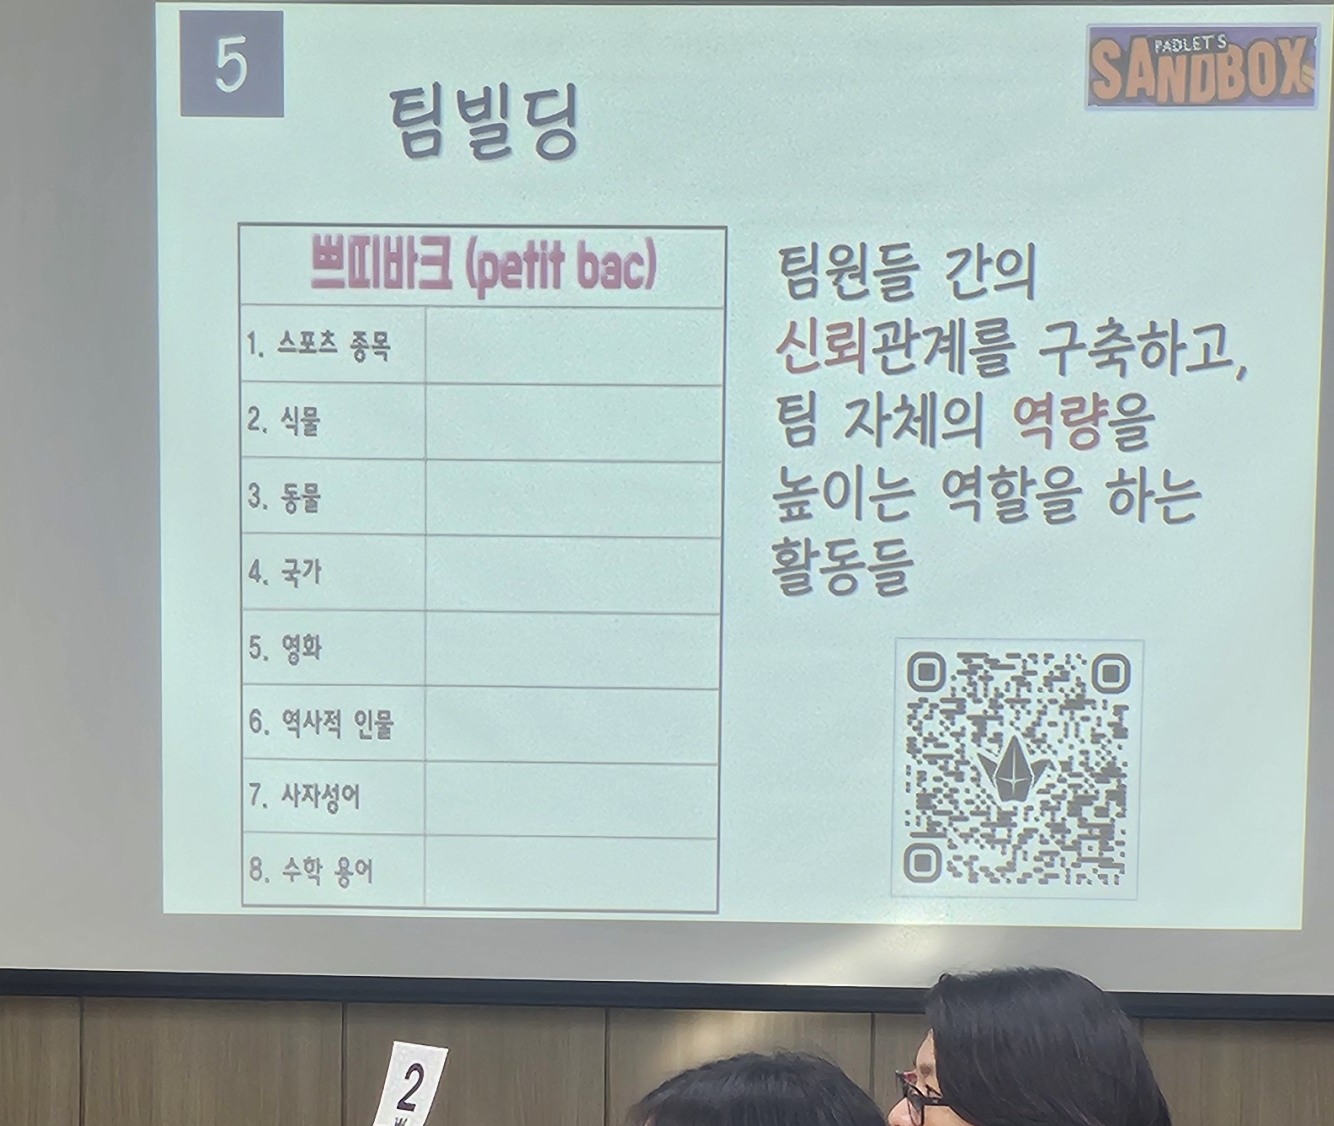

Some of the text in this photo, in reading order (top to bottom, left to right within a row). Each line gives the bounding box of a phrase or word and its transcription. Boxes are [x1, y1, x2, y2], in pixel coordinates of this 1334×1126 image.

[217, 36, 248, 93] 5
[1154, 33, 1228, 54] PADLET'S
[1091, 37, 1310, 104] SANDBOX
[390, 82, 578, 162] 팀빌딩
[311, 234, 657, 300] 쁘띠바크 (petit bac)
[779, 242, 1036, 303] 팀원들 간의
[247, 330, 391, 363] 1. 스포츠 종목
[776, 316, 1248, 383] 신뢰관계를 구축하고,
[248, 406, 321, 437] 2. 식물
[777, 390, 1156, 452] 팀 자체의 역량을
[248, 483, 322, 515] 3. 동물
[773, 464, 1202, 525] 높이는 역할을 하는
[248, 559, 322, 589] 4. 국가
[772, 536, 915, 597] 활동들
[249, 634, 322, 666] 5. 영화
[249, 709, 395, 740] 6. 역사적 인물
[249, 783, 360, 814] 7. 사자성어
[250, 856, 373, 888] 8. 수학 용어
[397, 1062, 425, 1112] 2
